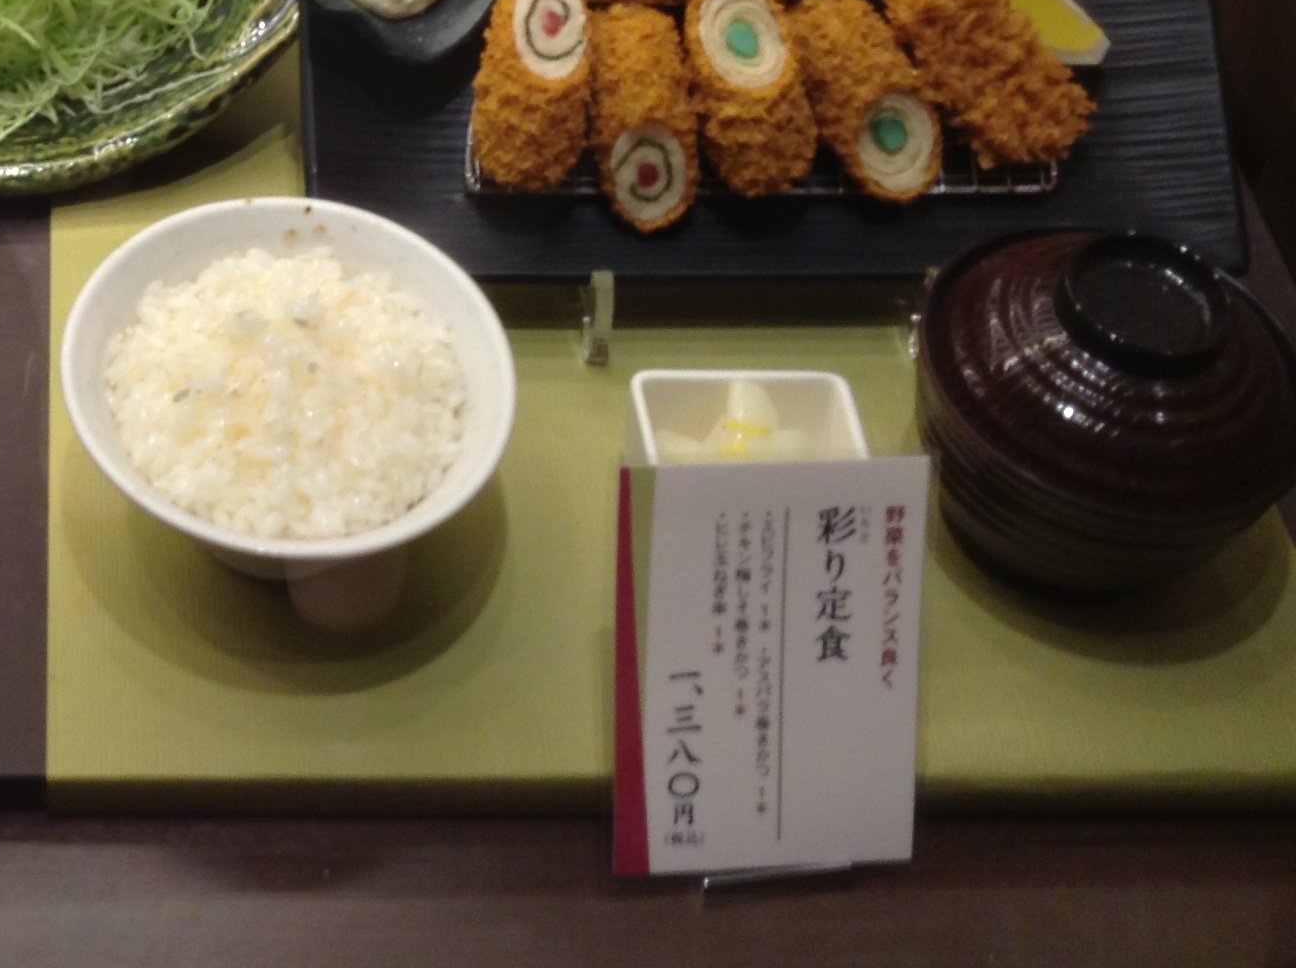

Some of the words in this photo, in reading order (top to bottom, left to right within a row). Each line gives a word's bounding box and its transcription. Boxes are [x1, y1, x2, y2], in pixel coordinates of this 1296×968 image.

[815, 505, 856, 663] 彩り定食
[879, 505, 907, 690] 野菜をバランス良く
